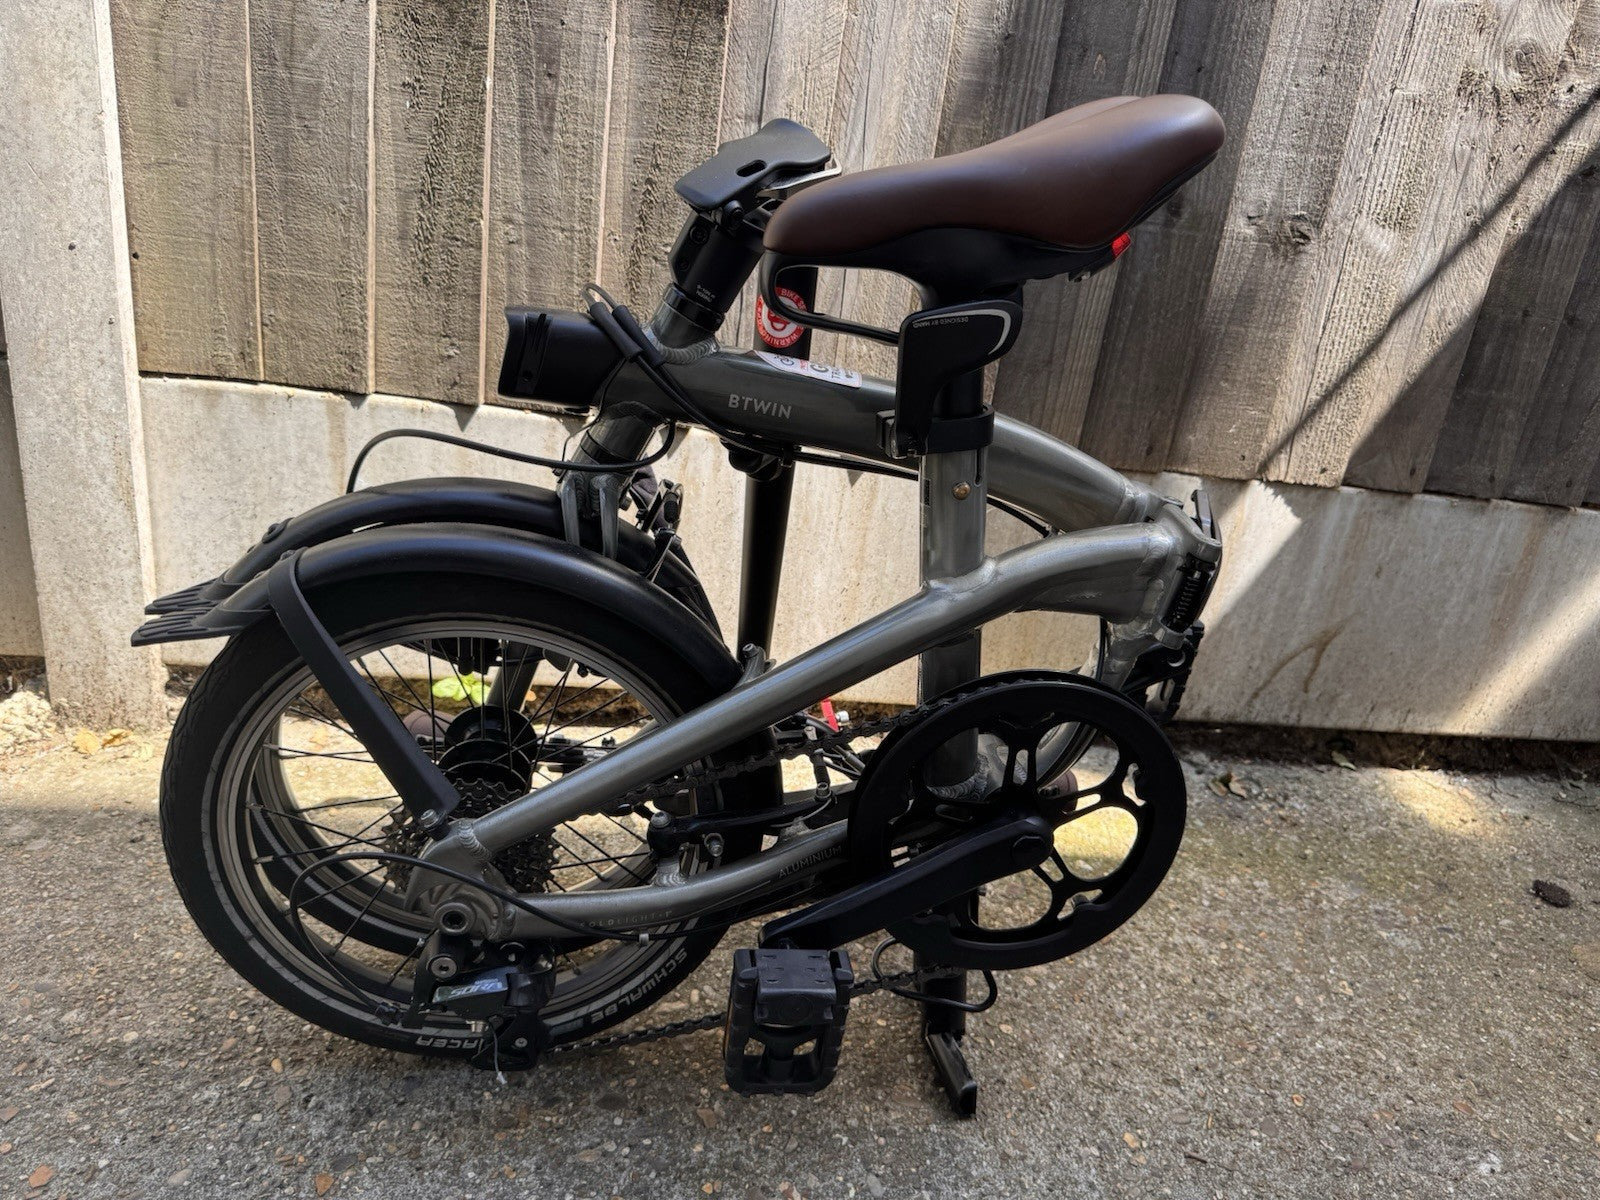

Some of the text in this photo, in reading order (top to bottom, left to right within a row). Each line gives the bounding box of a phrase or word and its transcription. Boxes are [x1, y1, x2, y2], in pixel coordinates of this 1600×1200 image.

[781, 289, 800, 302] BIKE
[761, 330, 799, 346] WARNING
[728, 393, 792, 419] BTWIN
[779, 845, 842, 878] ALUMINIUM
[590, 947, 688, 1023] SCHWALBE
